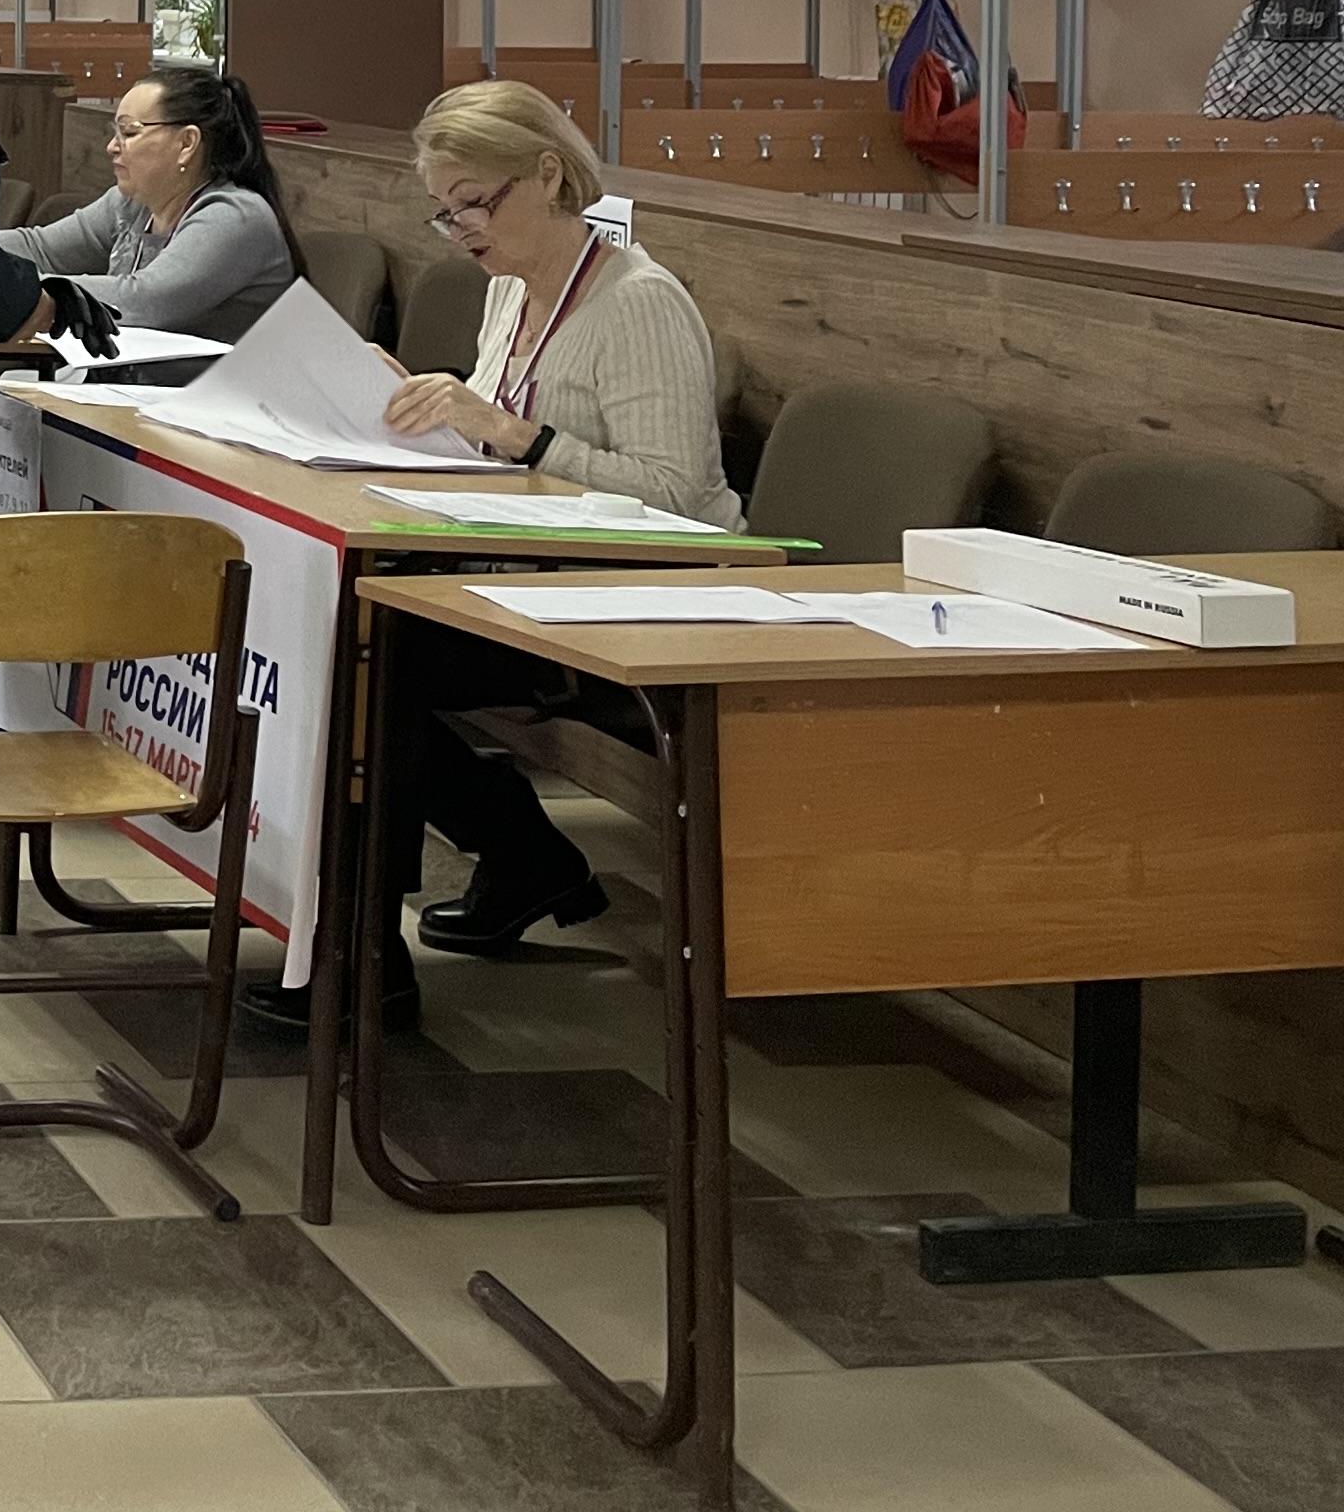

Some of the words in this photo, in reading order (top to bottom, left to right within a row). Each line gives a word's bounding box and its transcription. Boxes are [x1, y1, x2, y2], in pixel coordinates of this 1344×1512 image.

[1292, 7, 1324, 29] Bag
[1119, 595, 1142, 609] MADE
[1144, 600, 1153, 610] IN
[1155, 603, 1184, 618] RUSSIA
[107, 659, 207, 744] РОССИИ
[146, 735, 202, 795] МАРТ
